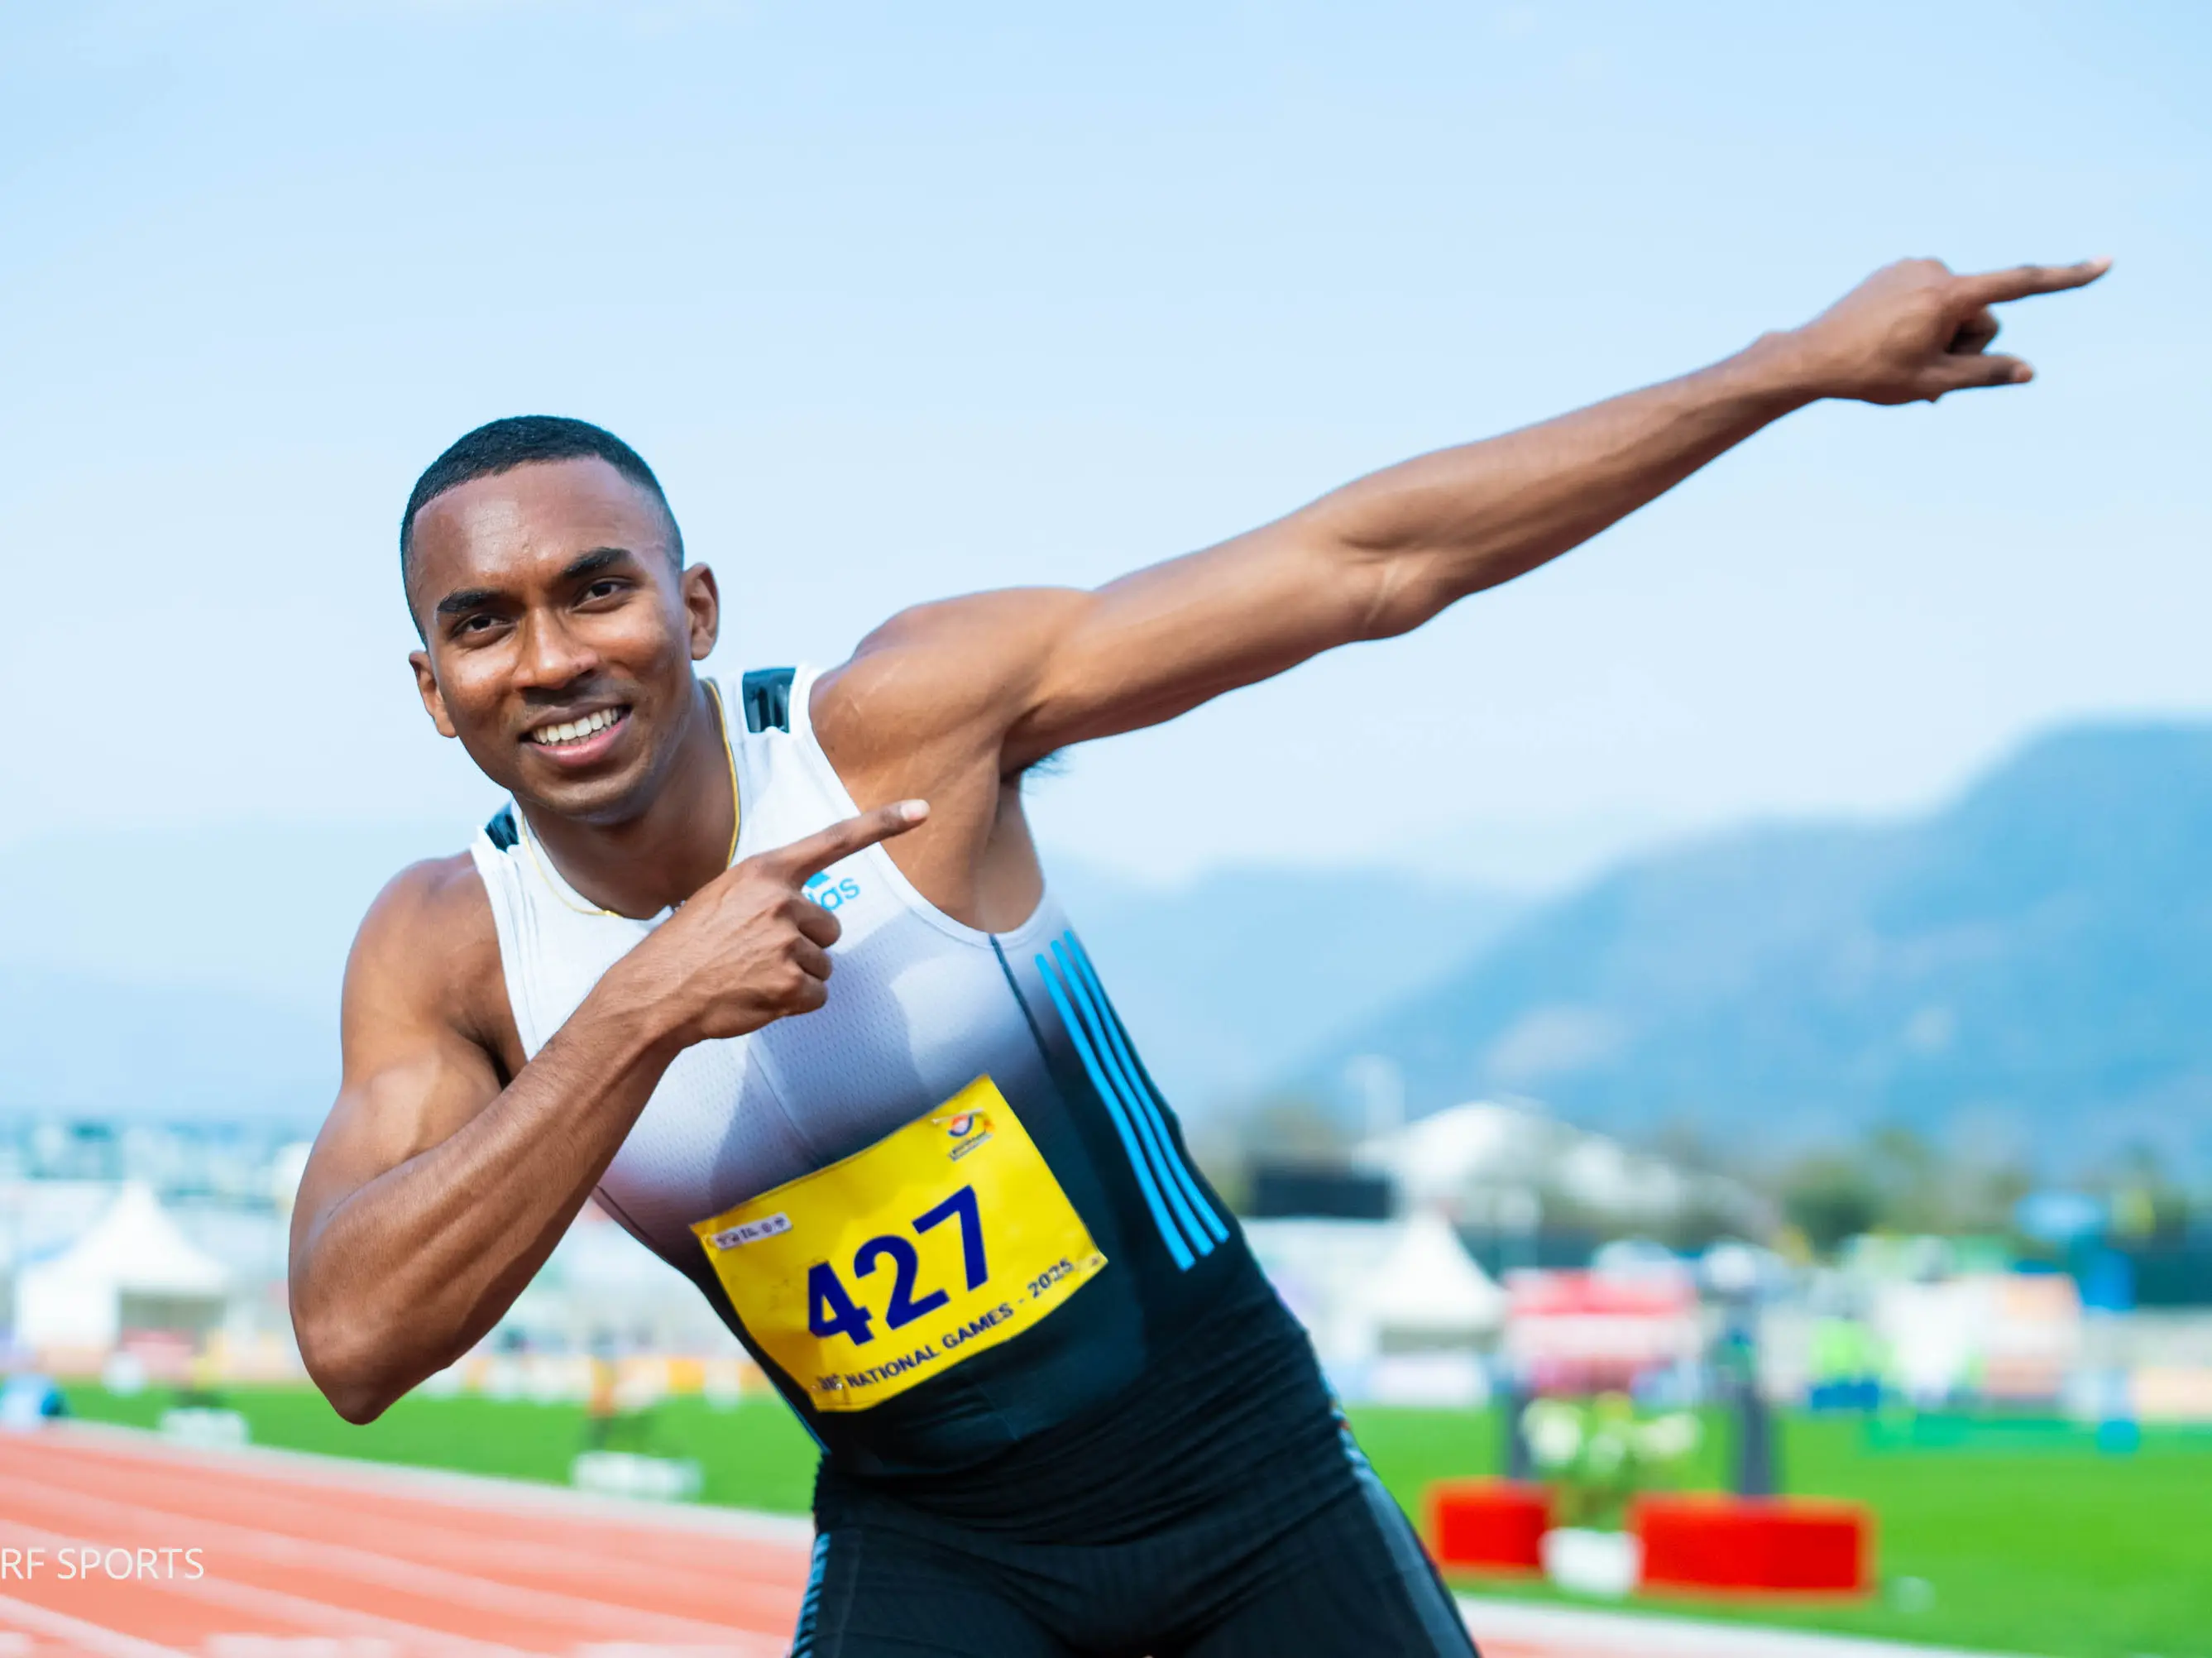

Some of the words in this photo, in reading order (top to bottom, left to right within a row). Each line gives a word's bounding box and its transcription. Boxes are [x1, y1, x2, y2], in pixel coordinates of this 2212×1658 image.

[807, 1184, 989, 1347] 427
[844, 1344, 942, 1388] NATIONAL
[941, 1301, 1014, 1349] GAMES
